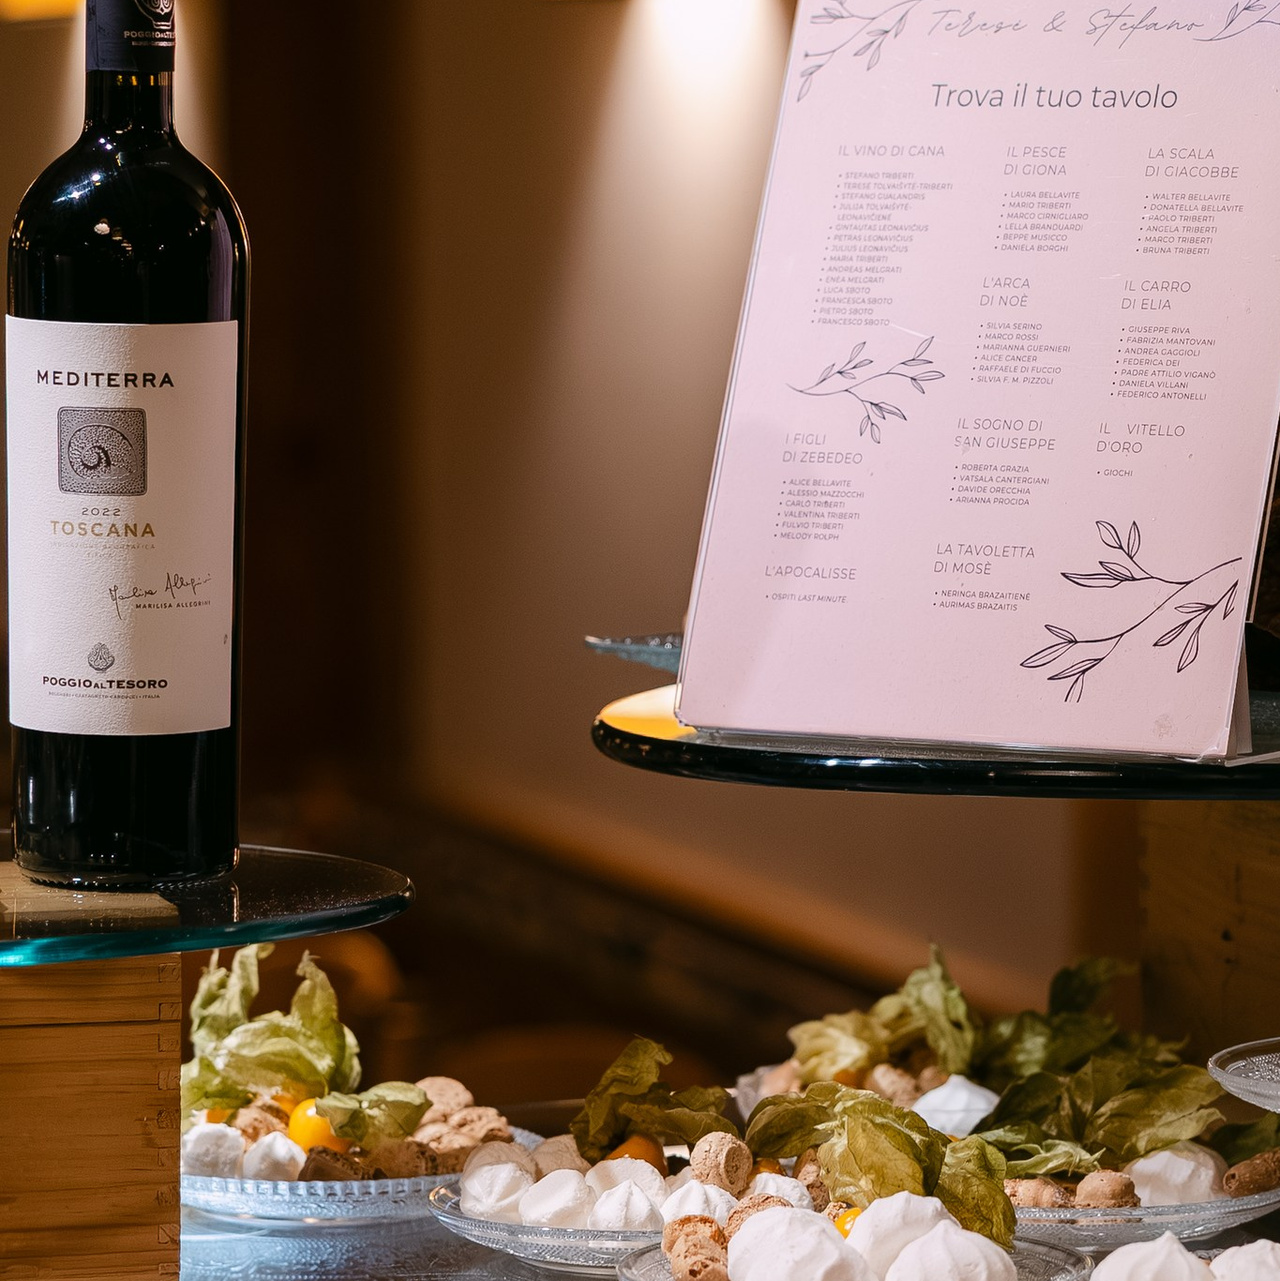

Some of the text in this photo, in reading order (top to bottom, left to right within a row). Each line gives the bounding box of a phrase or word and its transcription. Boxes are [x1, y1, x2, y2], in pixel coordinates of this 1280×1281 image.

[1042, 9, 1067, 34] &
[1086, 3, 1204, 49] Stefano
[932, 83, 1178, 108] Trova il tuo tavolo
[838, 145, 945, 156] IL VINO DI CANA
[1007, 146, 1067, 158] IL PESCE
[1148, 148, 1214, 159] LA SCALA
[1004, 164, 1067, 175] DI GIONA
[1145, 166, 1239, 178] DI GIACOBBE
[983, 277, 1030, 289] L'ARCA
[1125, 281, 1191, 292] IL CARRO
[980, 293, 1028, 307] DI NOÈ
[1122, 298, 1171, 310] DI ELIA
[986, 322, 1010, 330] SILVIA
[1031, 366, 1062, 374] FUCCIO
[1151, 370, 1182, 378] ATTILIO
[37, 370, 174, 387] MEDITERRA
[1160, 392, 1206, 400] ANTONELLI
[958, 418, 1042, 431] IL SOGNO DI
[1100, 423, 1185, 436] IL VITELLO
[785, 434, 826, 445] I FIGLI
[954, 436, 1056, 450] SAN GIUSEPPE
[1097, 441, 1142, 453] D'ORO
[783, 451, 863, 464] DI ZEBEDEO
[996, 476, 1049, 484] CANTERGIANI
[990, 486, 1030, 494] ORECCHIA
[82, 508, 121, 516] 2022
[51, 521, 155, 537] TOSCANA
[937, 544, 1035, 558] LA TAVOLETTA
[765, 566, 856, 580] L'APOCALISSE
[934, 561, 992, 575] DI MOSÈ
[941, 590, 976, 598] NERINGA
[939, 601, 1017, 611] AURIMAS BRAZAITIS
